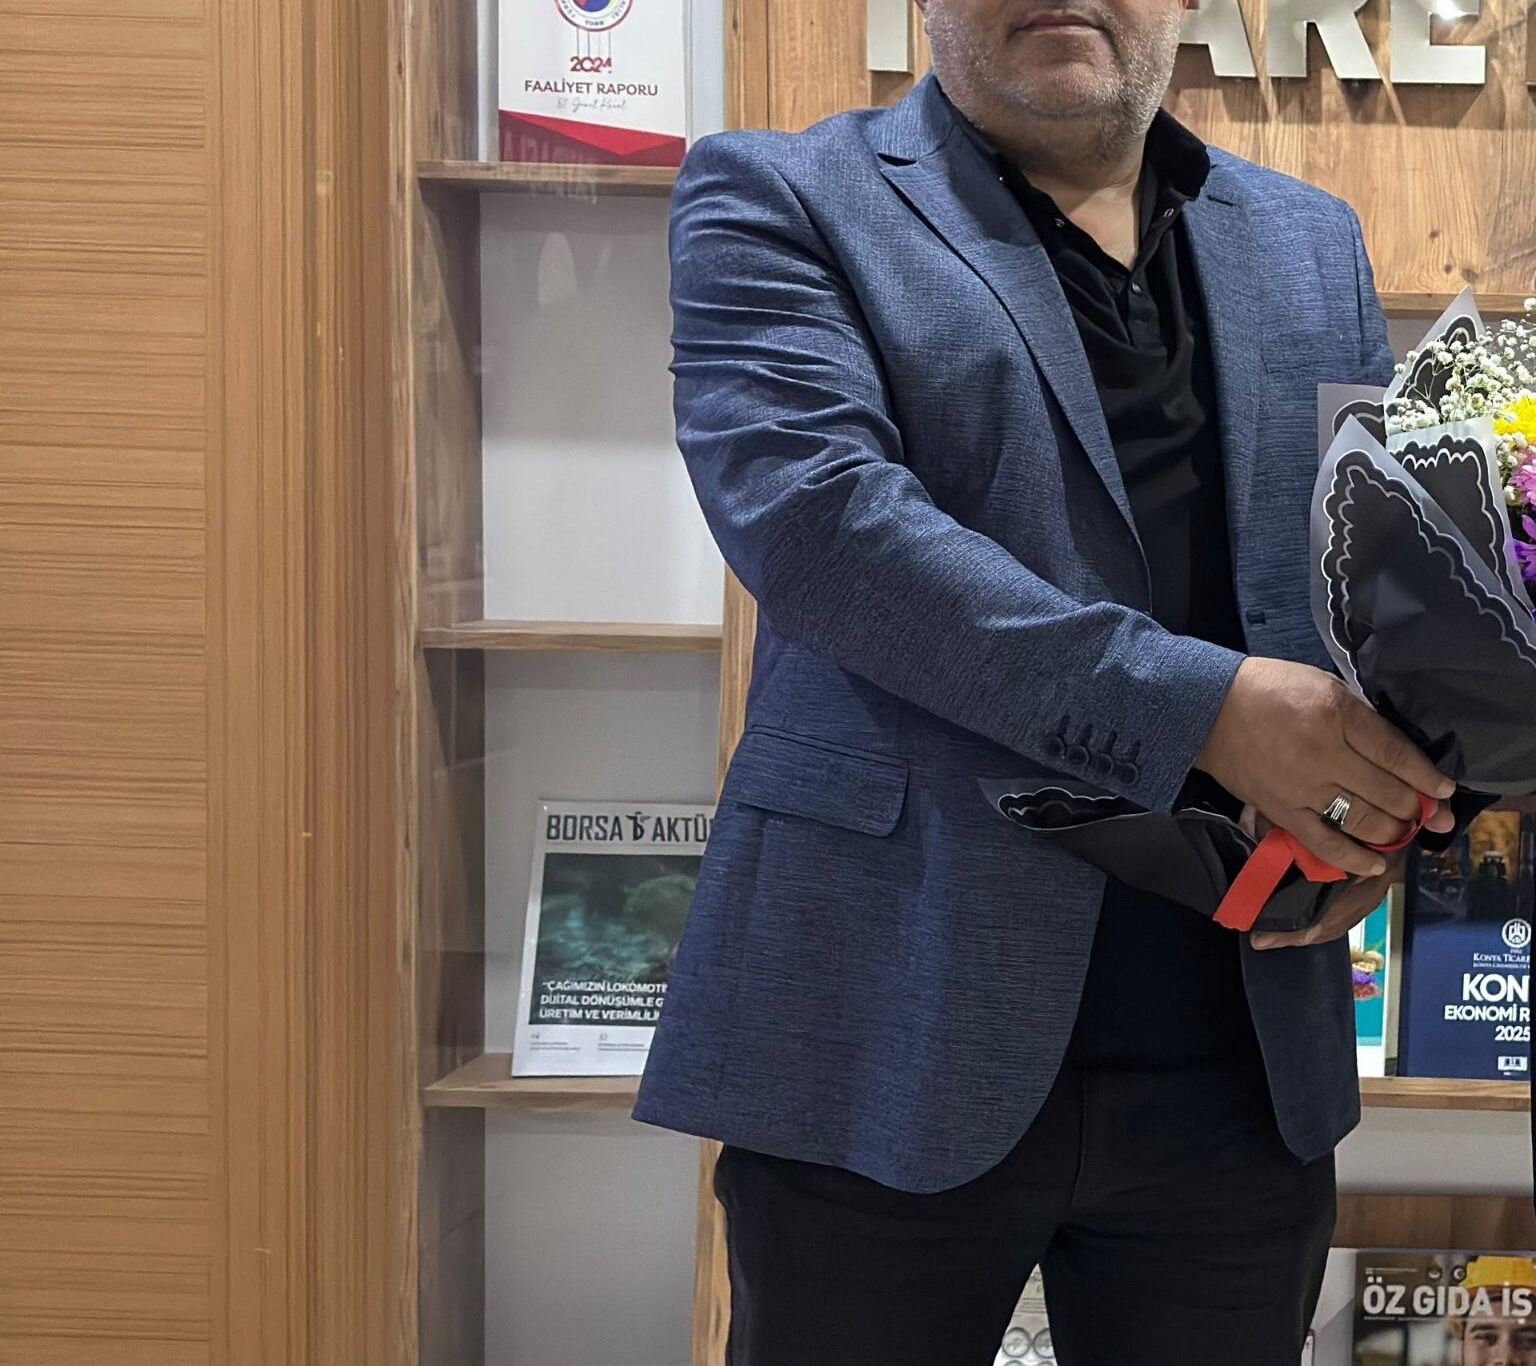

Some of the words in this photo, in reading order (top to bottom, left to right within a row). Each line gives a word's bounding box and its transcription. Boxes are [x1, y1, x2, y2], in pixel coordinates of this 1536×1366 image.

[570, 56, 612, 73] 2024
[524, 78, 592, 94] FAALİYET
[597, 83, 658, 96] RAPORU
[546, 813, 623, 842] BORSA
[651, 813, 707, 843] AKTÜ
[1473, 952, 1502, 962] KONYA
[606, 980, 668, 993] LOKOMOTİ
[1462, 973, 1530, 1002] KON
[581, 994, 654, 1008] DÖNÜŞÜMLE
[539, 1008, 583, 1019] ÜRETİM
[585, 1009, 600, 1019] VE
[600, 1008, 660, 1022] VERİMLİLİ
[1444, 1003, 1517, 1022] EKONOMİ
[1494, 1025, 1531, 1042] 2025
[1363, 1276, 1406, 1315] ÖZ
[1412, 1285, 1494, 1316] GIDA
[1502, 1281, 1533, 1325] İŞ
